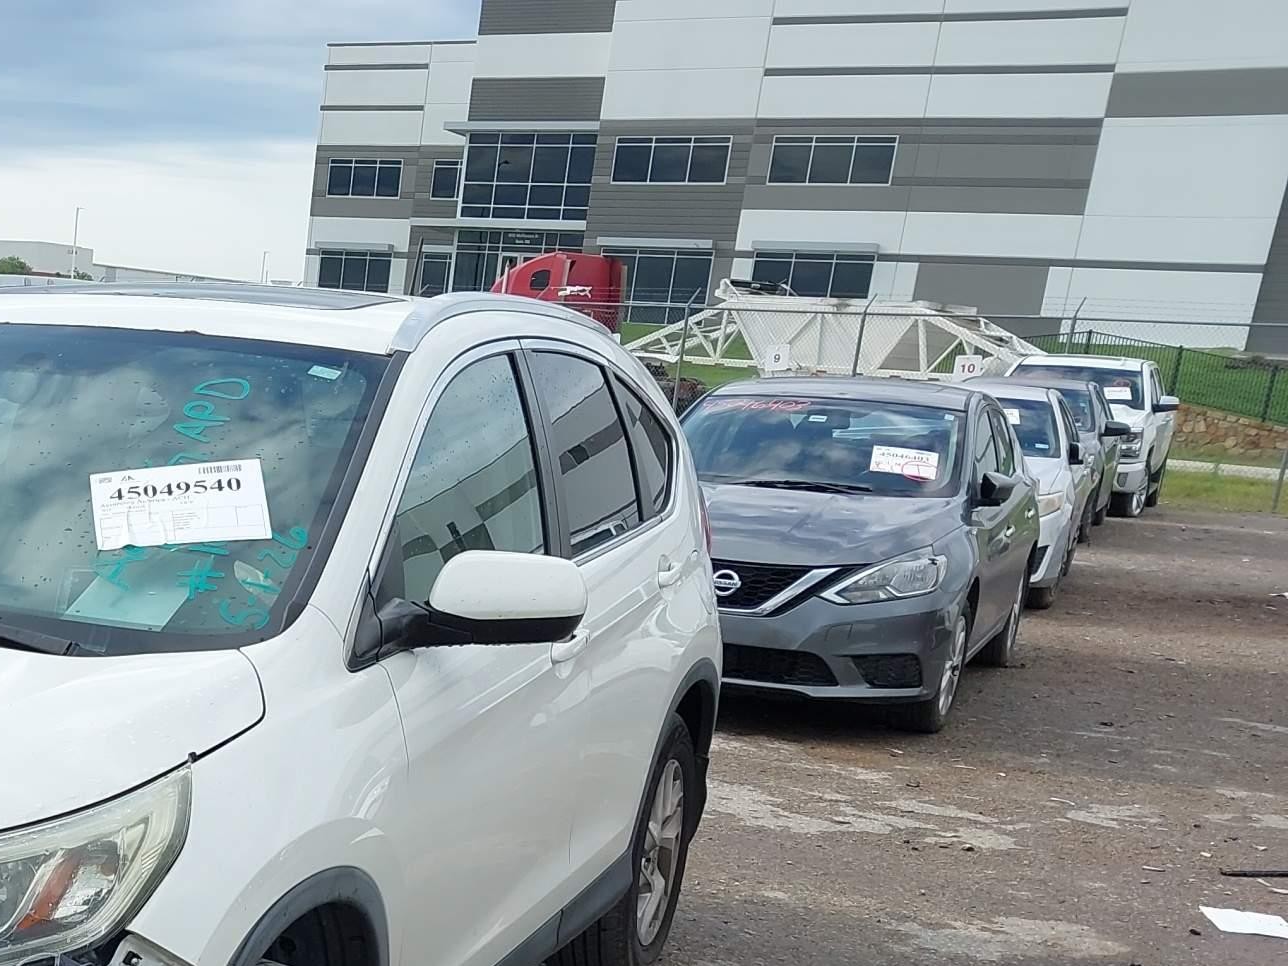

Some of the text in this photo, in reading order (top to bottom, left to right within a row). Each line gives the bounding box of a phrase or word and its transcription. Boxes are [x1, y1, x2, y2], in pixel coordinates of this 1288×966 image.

[773, 354, 781, 363] 9
[960, 364, 976, 374] 10
[173, 377, 251, 443] APD
[109, 477, 242, 501] 45049540
